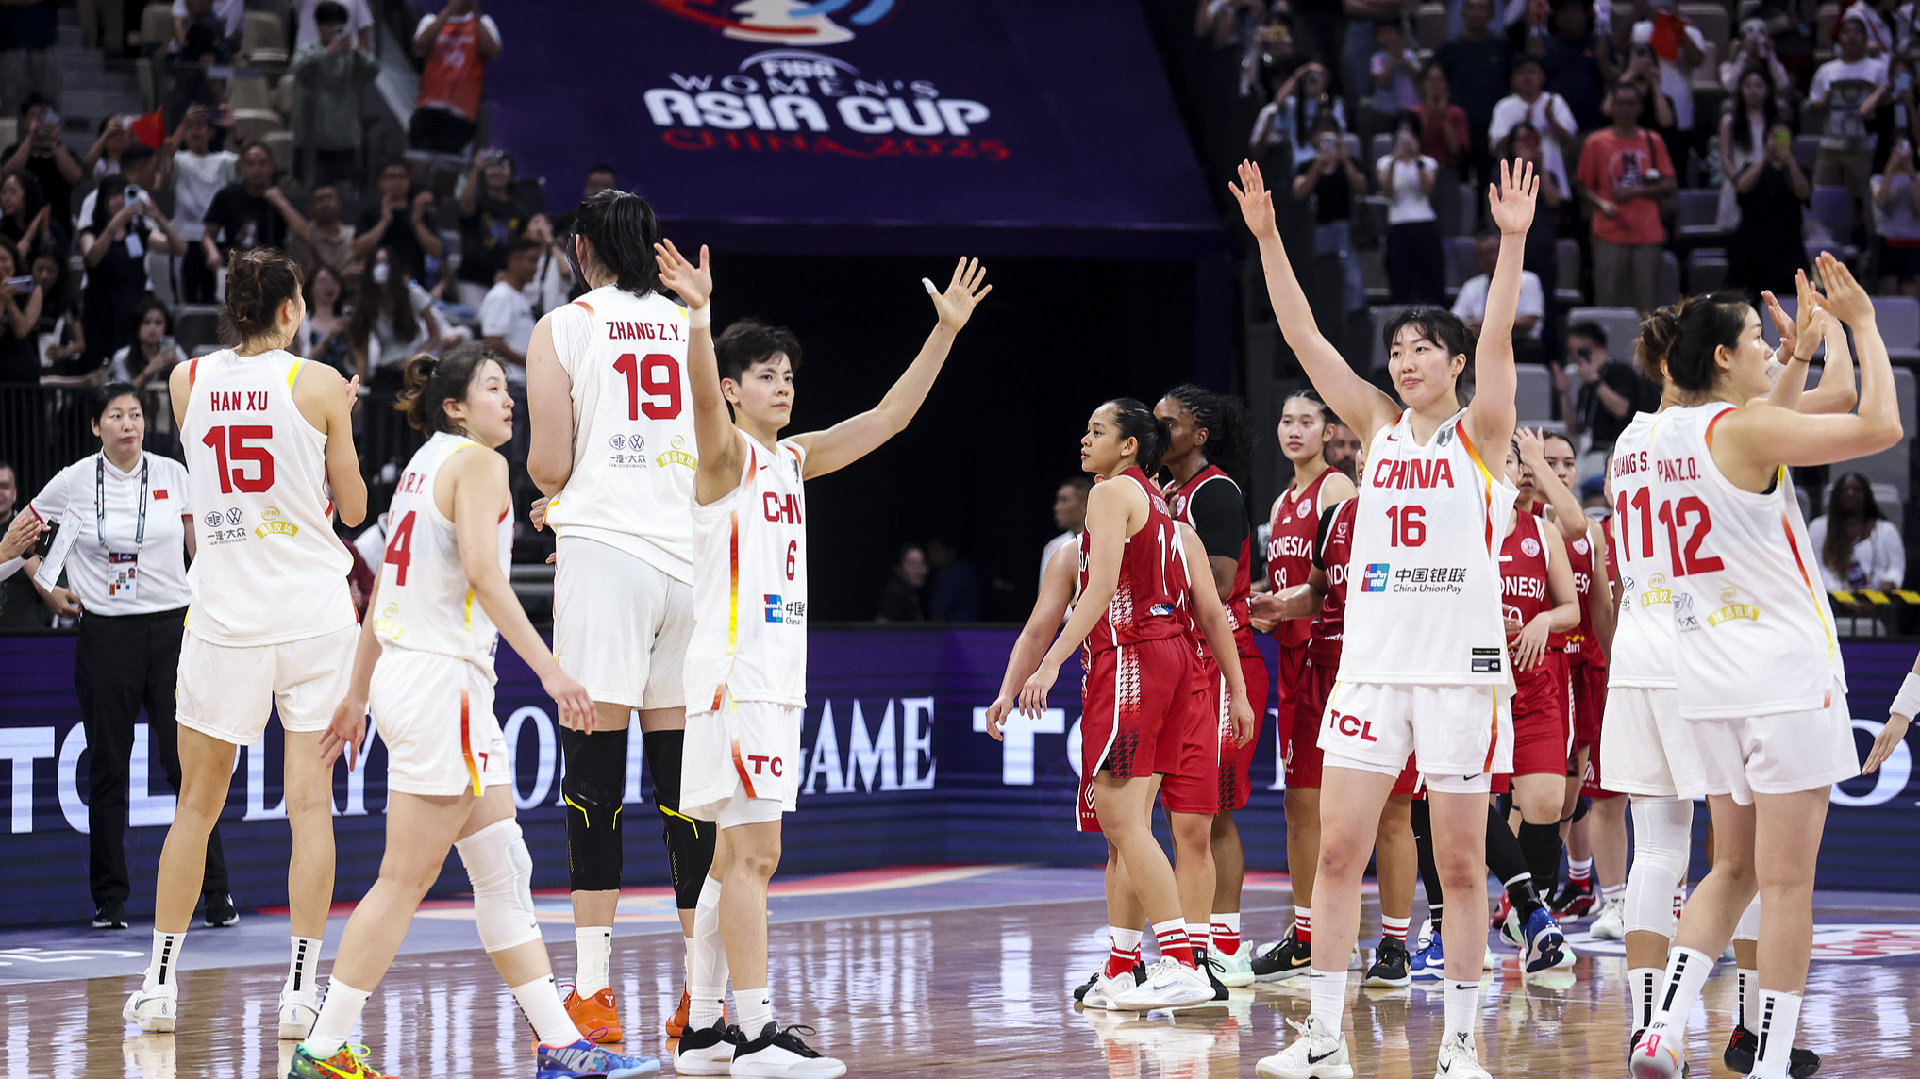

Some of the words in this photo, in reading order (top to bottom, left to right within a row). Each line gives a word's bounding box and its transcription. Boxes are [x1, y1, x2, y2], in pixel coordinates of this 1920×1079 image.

[669, 73, 940, 98] WOMEN'S
[643, 88, 831, 132] ASIA
[837, 95, 991, 136] CUP
[661, 128, 877, 159] CHINA
[864, 136, 1011, 161] 2025
[606, 322, 656, 340] ZHANG
[211, 392, 242, 412] HAN
[246, 391, 268, 411] XU
[613, 354, 682, 421] 19
[202, 425, 275, 494] 15
[1373, 458, 1455, 490] CHINA
[1386, 505, 1426, 547] 16
[1615, 486, 1654, 562] 11
[1658, 495, 1725, 577] 12
[786, 540, 797, 581] 6
[1395, 568, 1467, 583] 中国银联
[1393, 584, 1417, 592] China
[1420, 584, 1462, 595] UnionPay
[1331, 709, 1377, 742] TCL
[800, 697, 936, 796] AME
